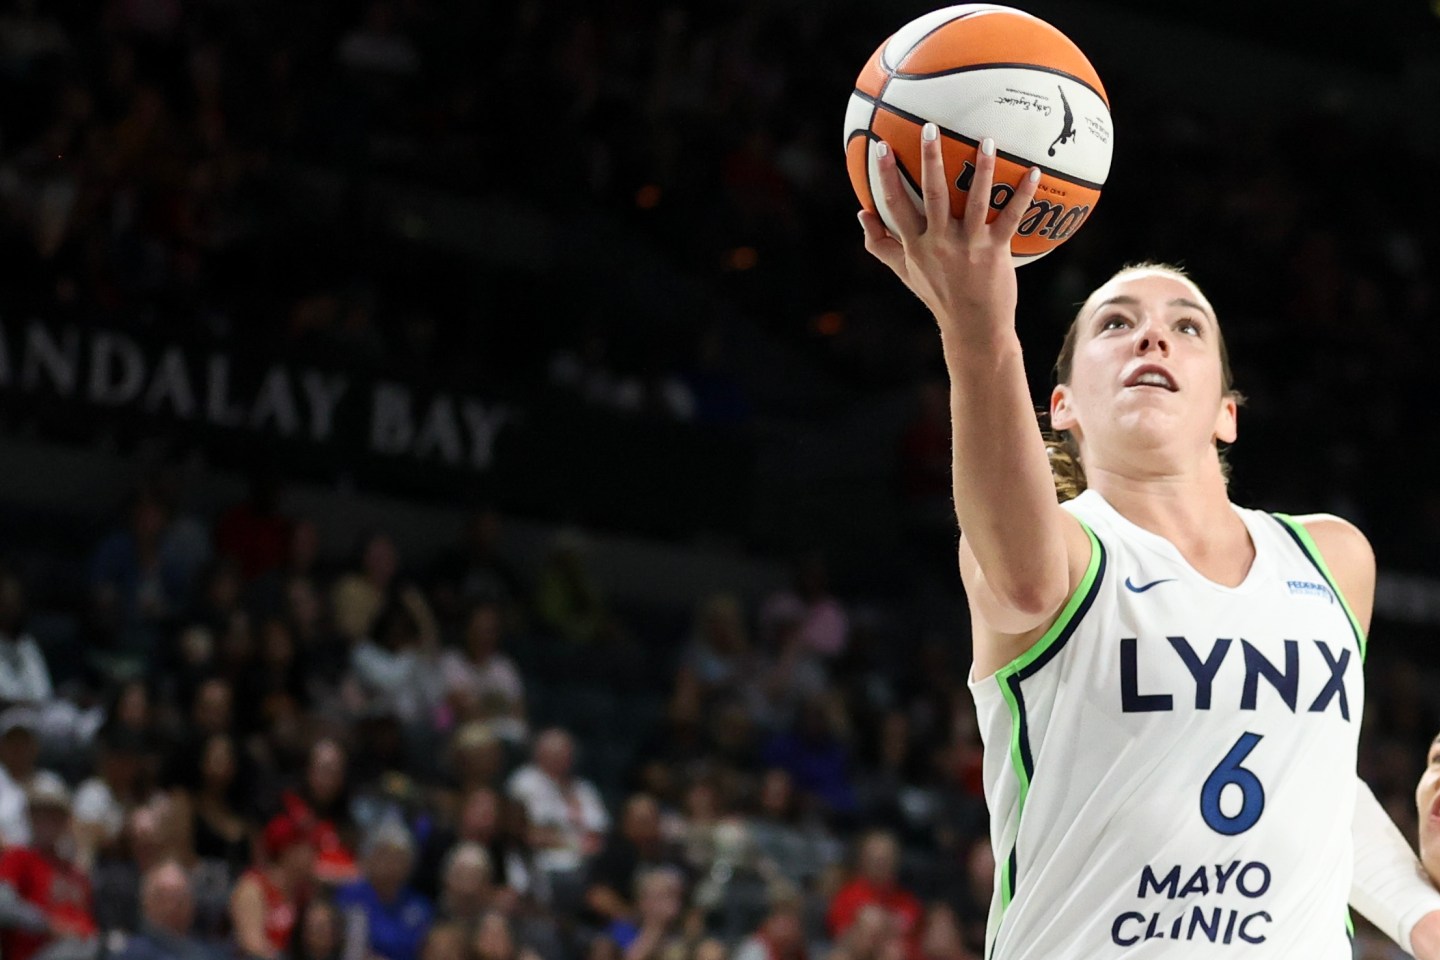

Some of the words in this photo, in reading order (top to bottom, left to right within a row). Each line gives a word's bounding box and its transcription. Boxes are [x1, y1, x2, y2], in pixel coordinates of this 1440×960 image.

[955, 161, 1090, 240] Wilon
[0, 318, 350, 442] NDALAY
[369, 378, 505, 470] BAY
[1120, 636, 1351, 723] LYNX
[1200, 731, 1265, 836] 6
[1137, 861, 1271, 899] MAYO
[1111, 906, 1273, 947] CLINIC
